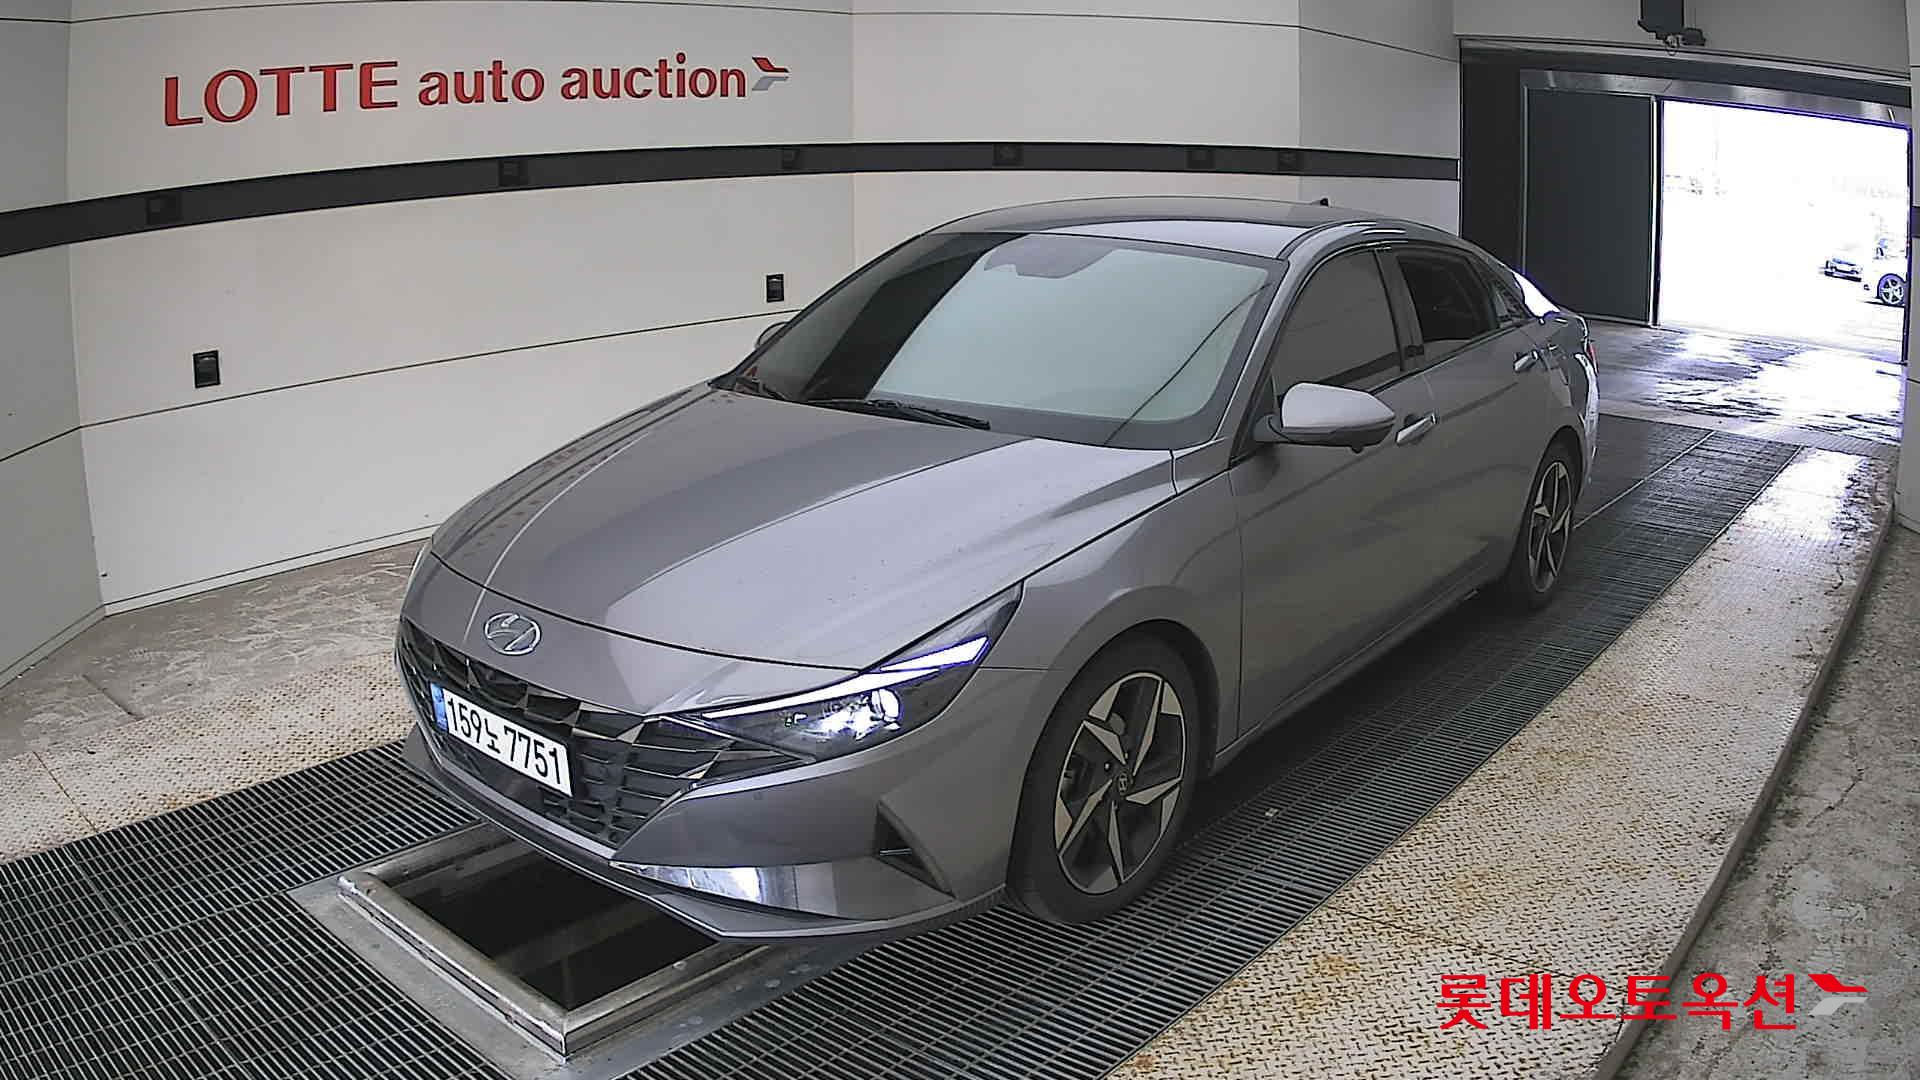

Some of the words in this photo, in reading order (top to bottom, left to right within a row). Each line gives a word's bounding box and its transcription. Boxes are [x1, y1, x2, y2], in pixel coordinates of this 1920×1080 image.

[164, 60, 400, 127] LOTTE
[417, 60, 545, 106] auto
[559, 51, 747, 100] auction
